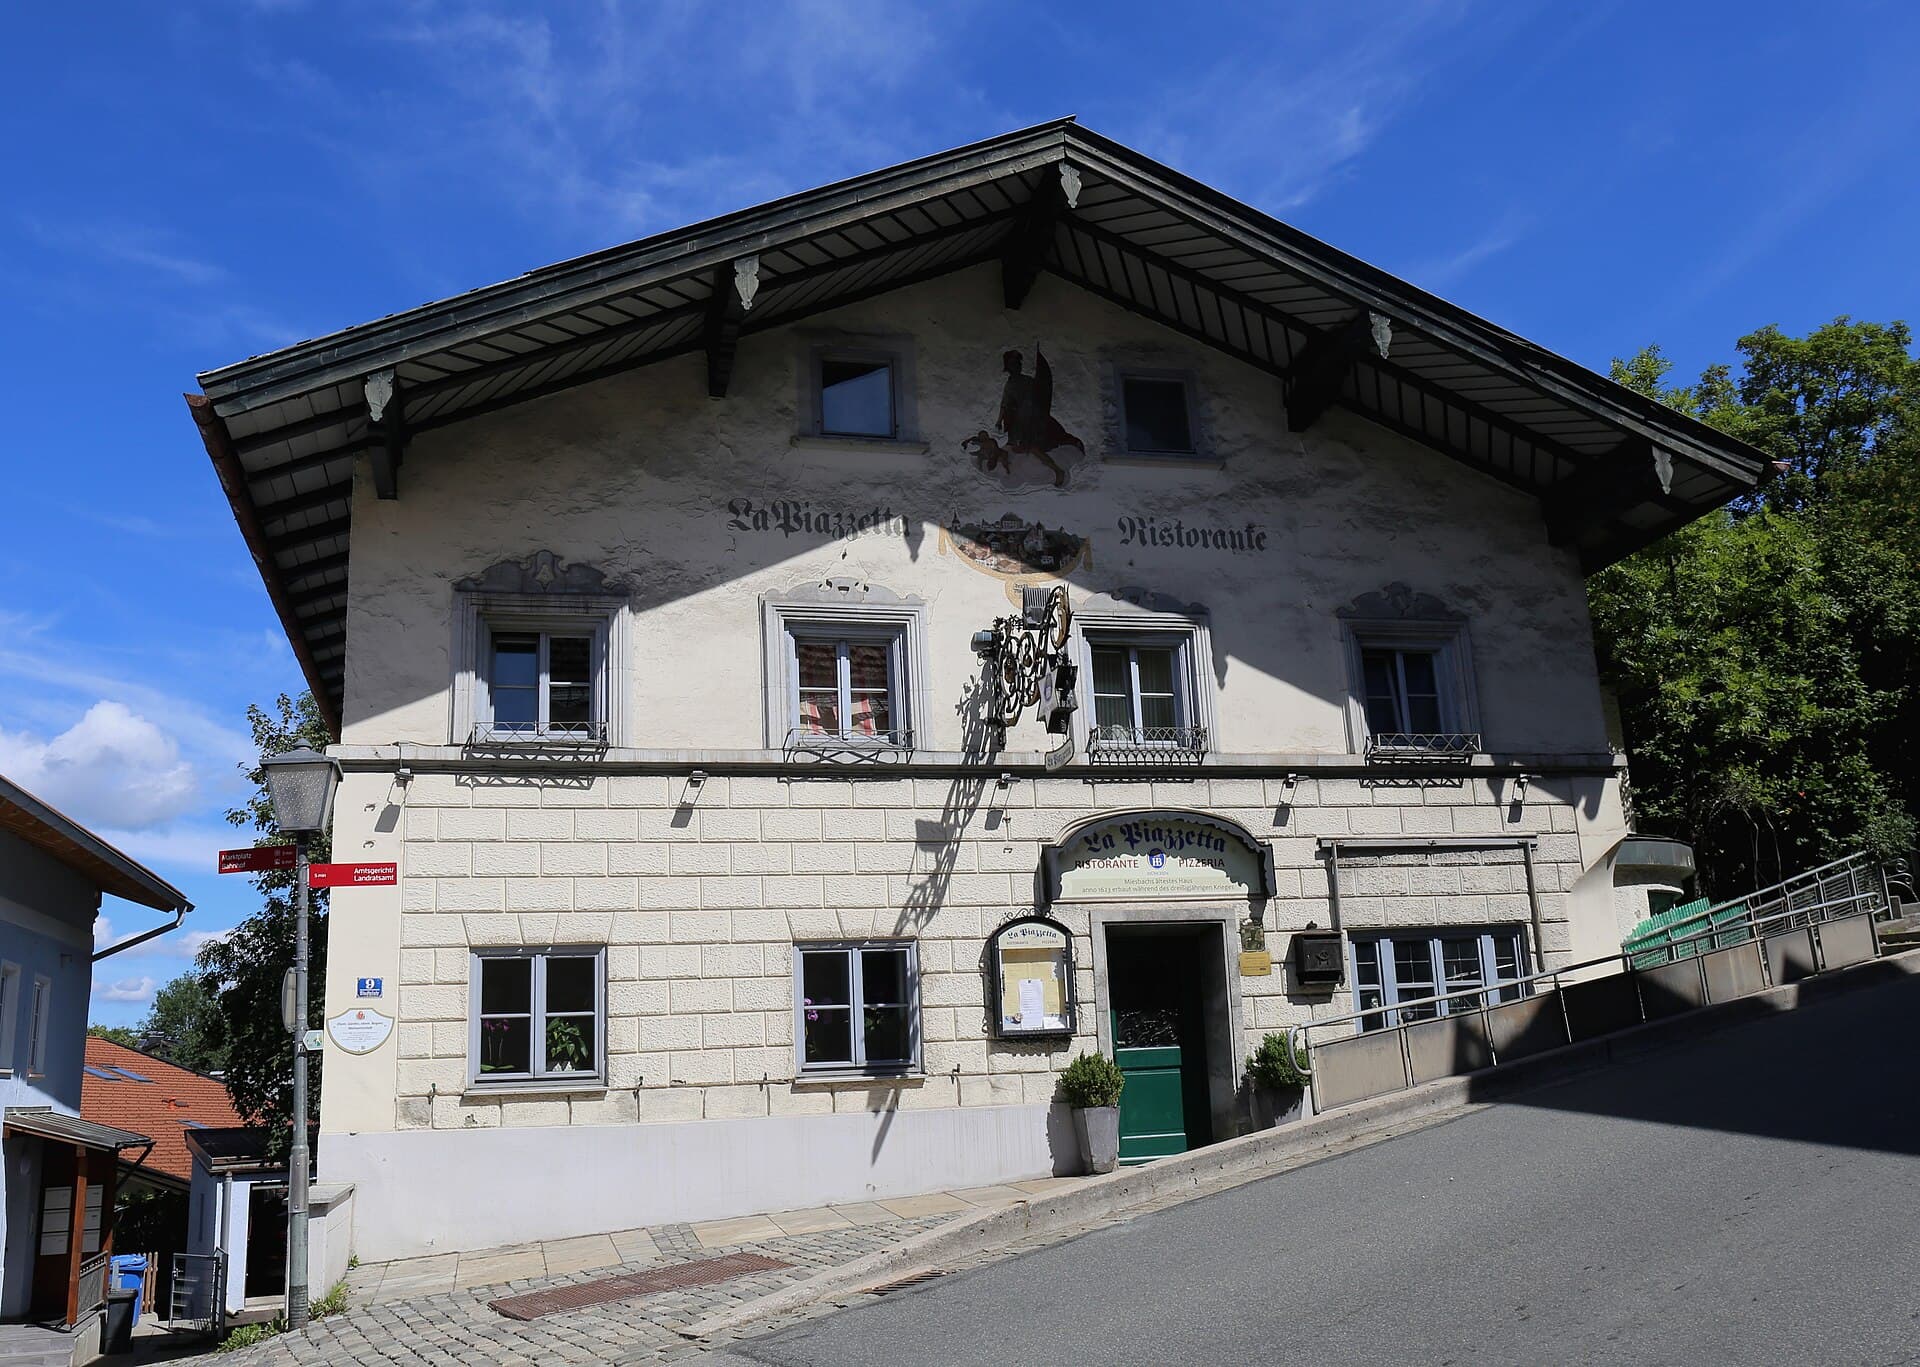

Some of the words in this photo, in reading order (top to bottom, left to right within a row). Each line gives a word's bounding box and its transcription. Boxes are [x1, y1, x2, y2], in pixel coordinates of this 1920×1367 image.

[1117, 515, 1268, 552] Ristorante
[1083, 831, 1116, 853] La
[1119, 822, 1226, 853] Piazzetta
[221, 853, 252, 862] Marktplatz
[221, 862, 247, 870] Bahnhof
[1074, 859, 1140, 869] RISTORANTE
[1178, 858, 1226, 868] PIZZERIA
[353, 867, 395, 875] Amtsgericht/
[1124, 878, 1155, 886] Miesbachs
[1132, 885, 1158, 893] während
[1007, 931, 1019, 939] La
[1020, 928, 1057, 938] Piazzetta
[365, 978, 375, 990] 9
